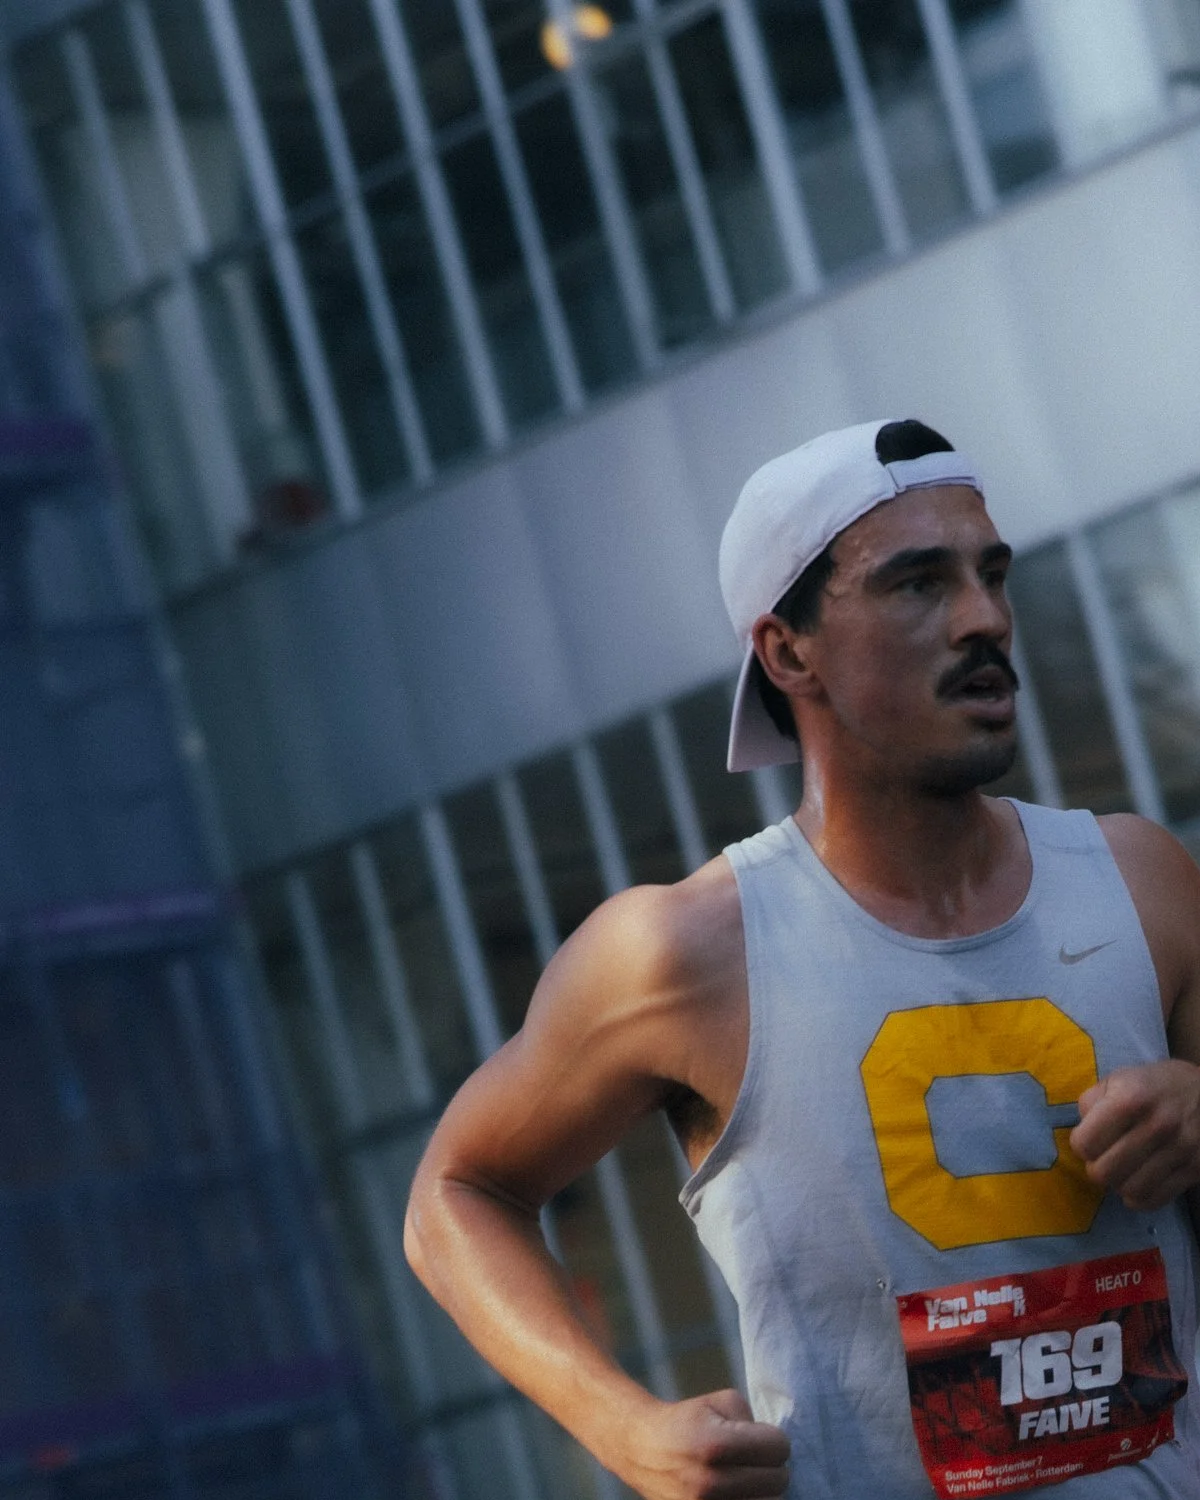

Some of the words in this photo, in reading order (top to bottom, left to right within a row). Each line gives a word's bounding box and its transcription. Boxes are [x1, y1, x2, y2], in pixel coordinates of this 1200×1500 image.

[859, 996, 1104, 1251] C
[1095, 1271, 1132, 1292] HEAT
[924, 1296, 968, 1316] Van
[927, 1308, 987, 1332] Faive
[990, 1320, 1123, 1407] 169
[1018, 1396, 1110, 1441] FAIVE
[945, 1467, 984, 1482] Sunday
[985, 1457, 1036, 1476] September
[947, 1482, 966, 1494] Van
[968, 1480, 994, 1491] Nelle
[996, 1472, 1029, 1487] Fabriek
[1035, 1462, 1084, 1478] Rotterdam
